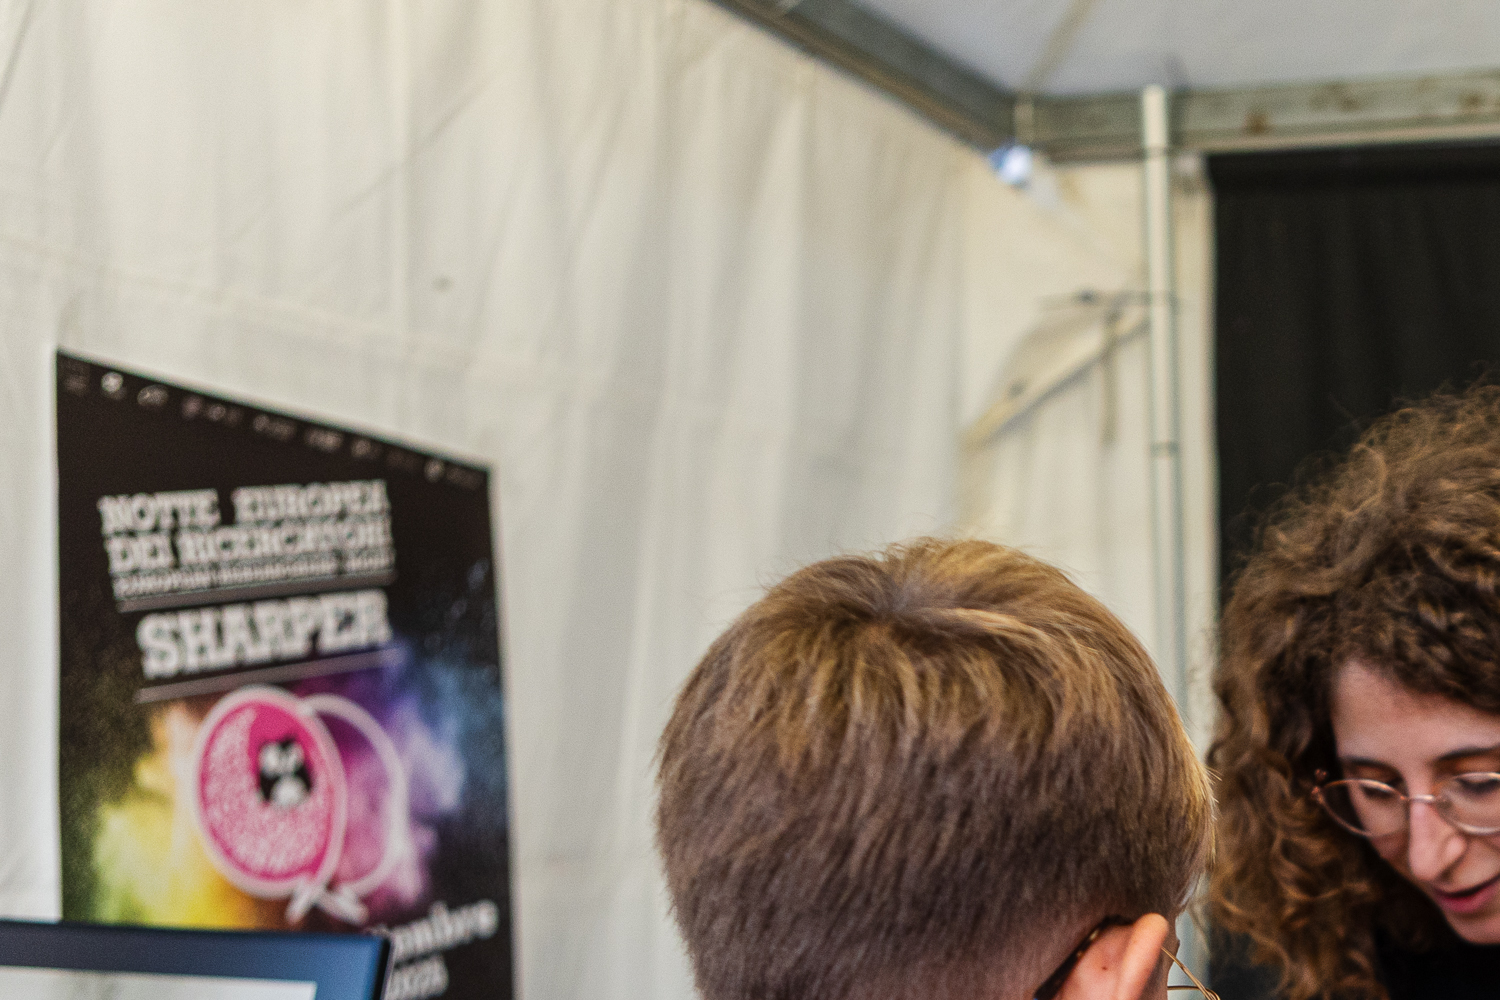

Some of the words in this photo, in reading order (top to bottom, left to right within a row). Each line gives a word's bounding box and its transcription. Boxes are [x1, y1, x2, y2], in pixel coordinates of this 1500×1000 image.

[98, 488, 221, 535] NOTTE
[104, 530, 174, 573] DEI
[135, 588, 393, 680] SHARPER
